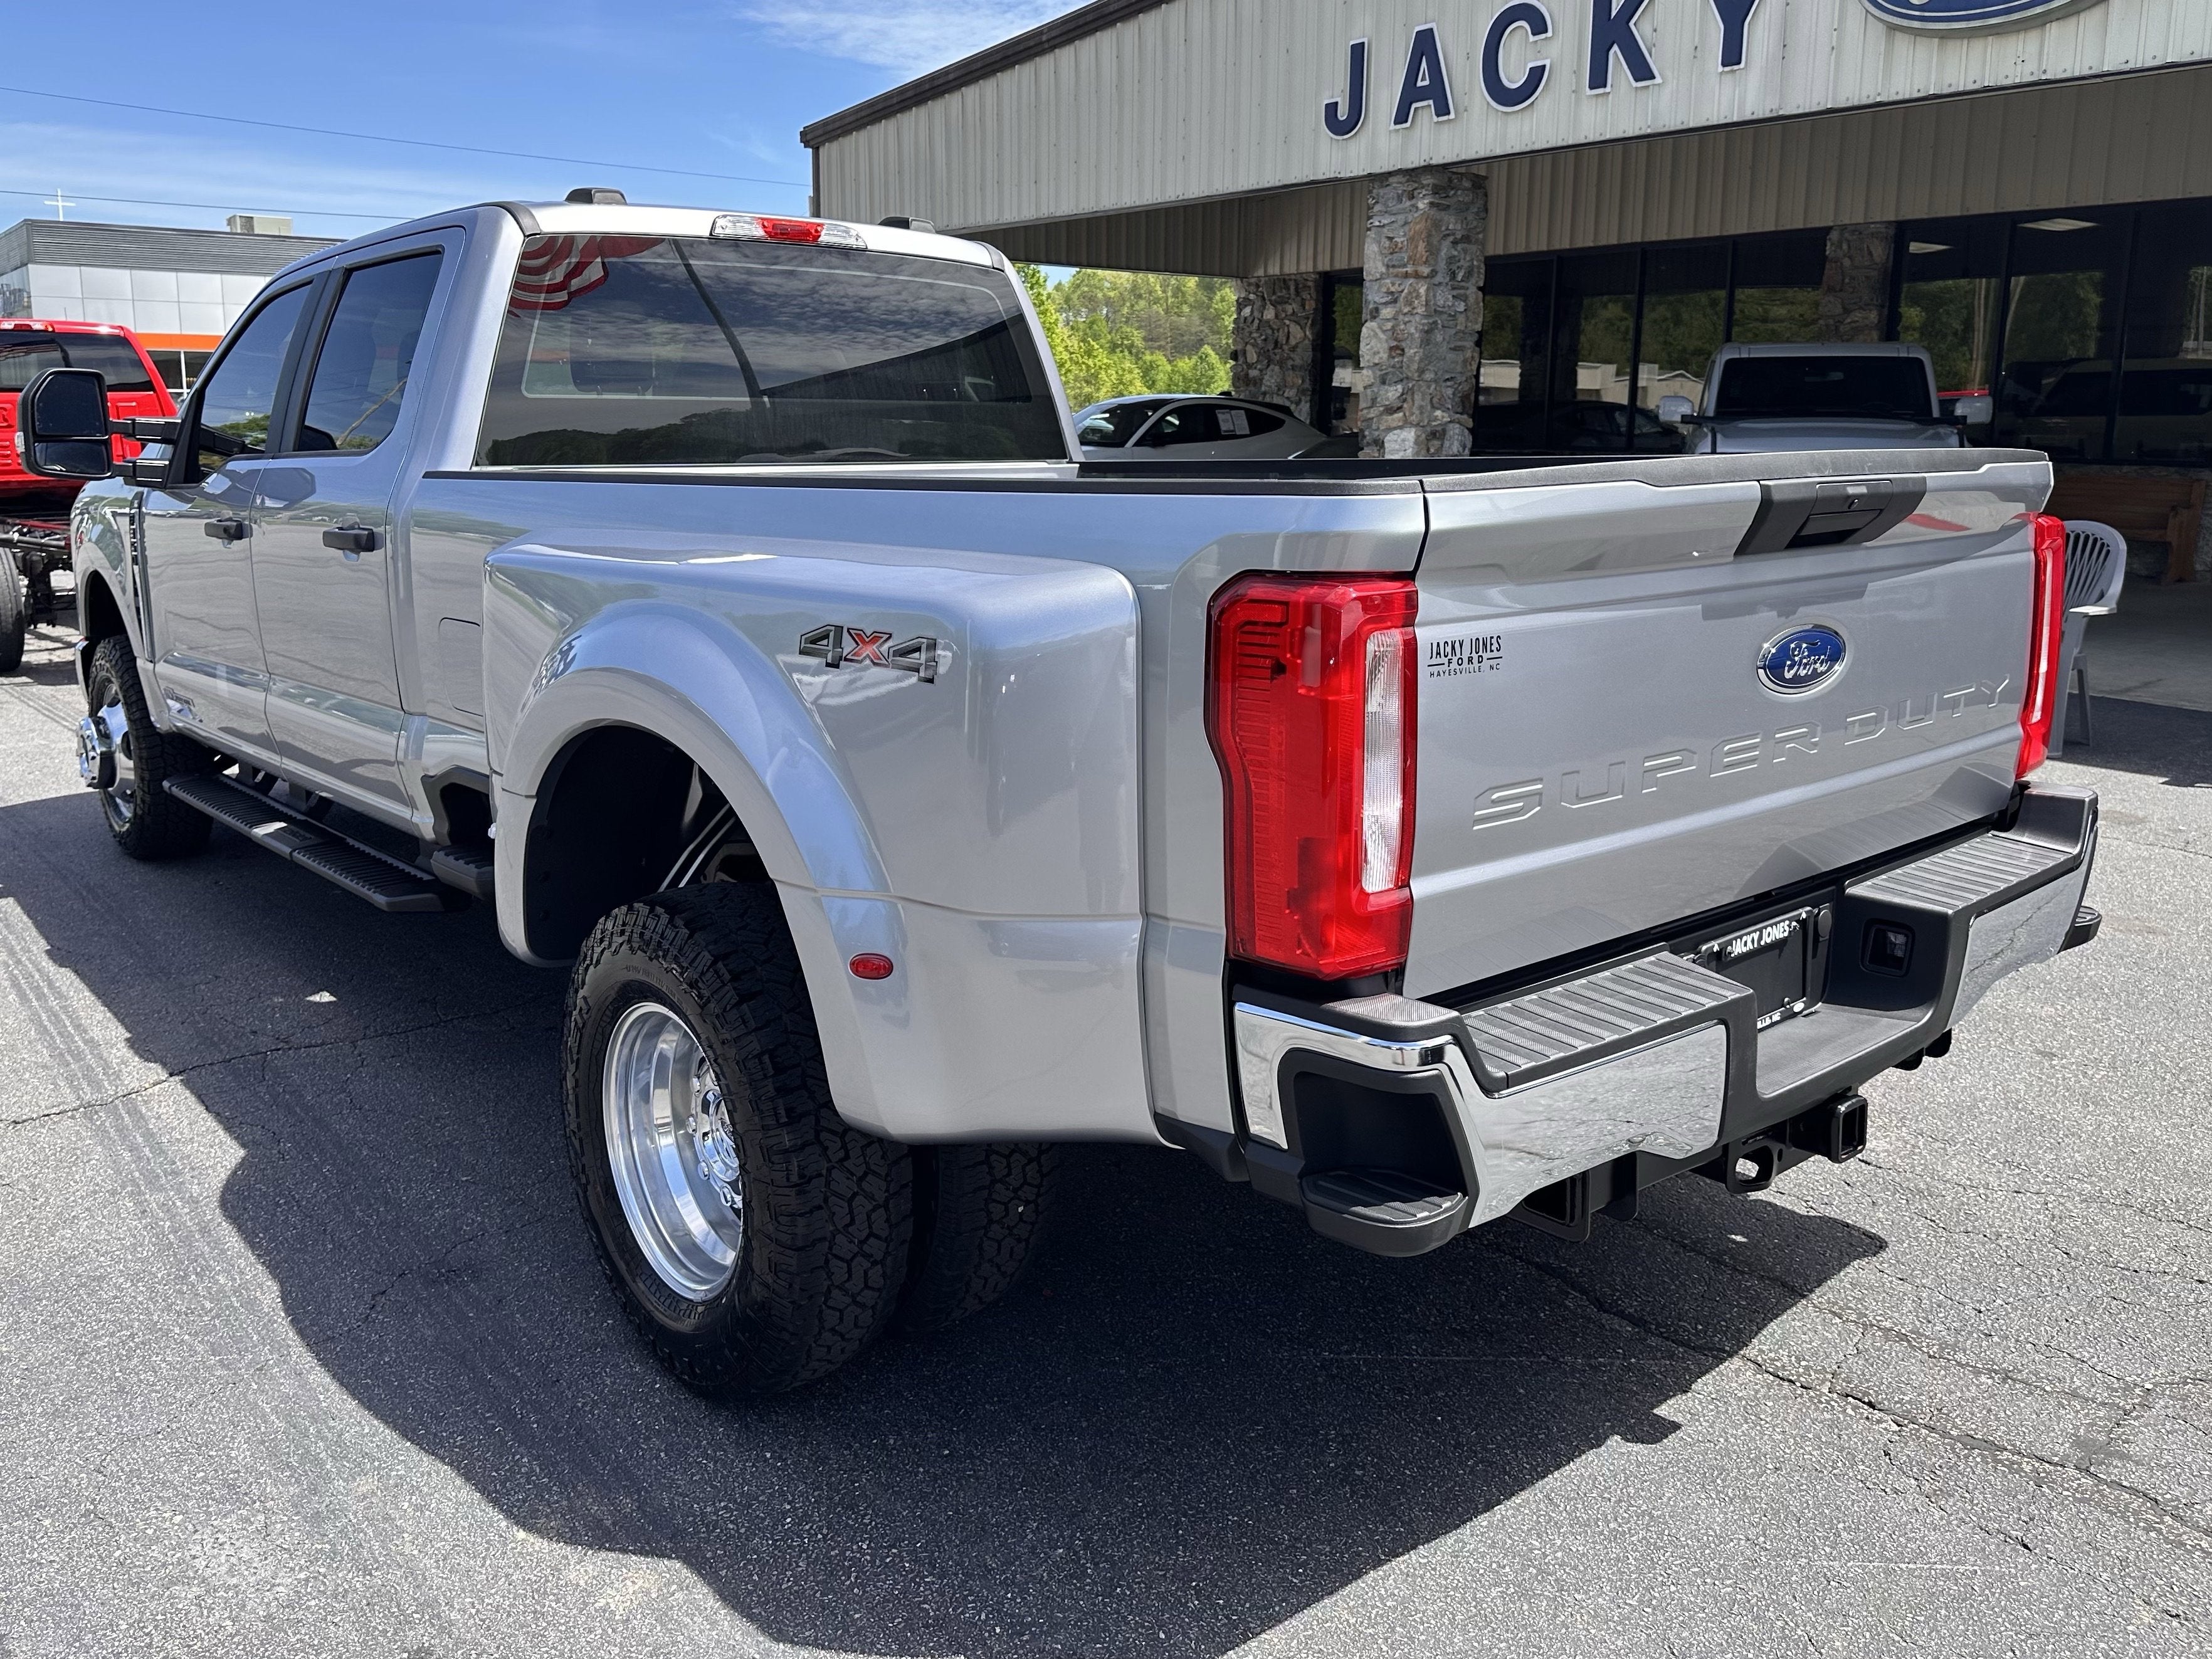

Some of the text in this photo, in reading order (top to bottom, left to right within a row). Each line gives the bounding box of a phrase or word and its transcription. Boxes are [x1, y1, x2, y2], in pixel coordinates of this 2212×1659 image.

[1323, 0, 1761, 140] JACKY
[1430, 635, 1502, 660] JACKY JONES
[1447, 655, 1483, 668] FORD
[1784, 640, 1831, 679] Ford
[1430, 663, 1500, 678] HAYESVILLE, NC
[1472, 673, 2011, 831] SUPER DUTY
[1730, 920, 1789, 957] JACKY JONES
